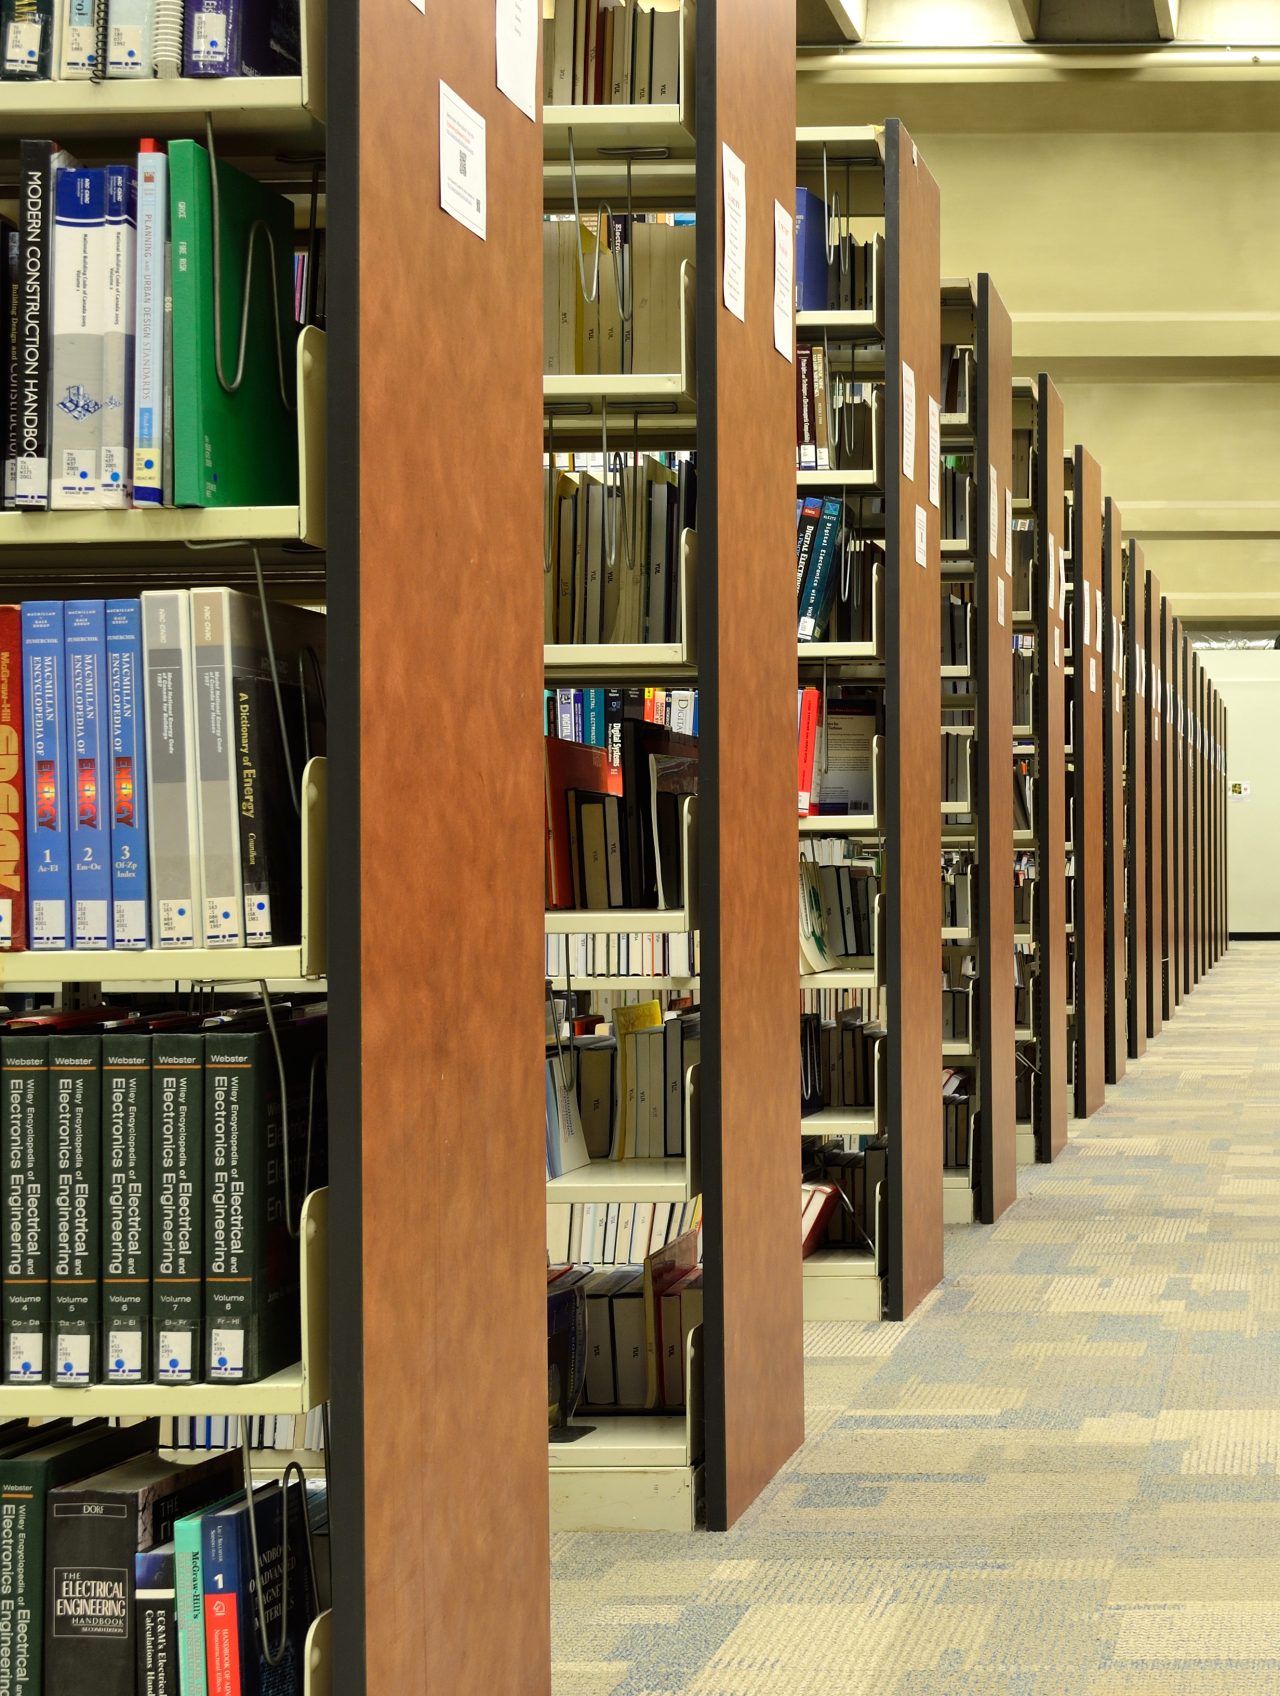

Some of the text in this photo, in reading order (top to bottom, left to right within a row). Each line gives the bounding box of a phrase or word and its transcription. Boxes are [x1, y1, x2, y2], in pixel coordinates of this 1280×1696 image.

[144, 214, 152, 258] PLANNING
[178, 241, 188, 272] FIRE RISK
[143, 274, 152, 304] URBAN
[22, 171, 42, 458] MODERN CONSTRUCTION HANDBO
[143, 307, 152, 339] DESIGN
[142, 342, 152, 400] STANDARDS
[822, 522, 832, 546] Digital
[813, 549, 826, 587] Electronics
[44, 656, 54, 721] MACMILLAN
[34, 656, 57, 831] ENCYCLOPEDIA OF ENERGY
[239, 692, 256, 819] A Dictionary of Energy
[612, 722, 622, 767] Digital Systems
[44, 849, 52, 863] 1
[108, 1056, 146, 1065] Webster
[210, 1055, 249, 1063] Webster
[108, 1077, 126, 1275] Electronics Engineering
[127, 1077, 142, 1275] Wiley Encyclopedia of Electrical and
[211, 1076, 228, 1273] Electronics Engineering
[229, 1076, 245, 1274] Wiley Encyclopedia of Electrical and
[109, 1295, 142, 1303] Volume
[121, 1304, 128, 1312] 6
[213, 1294, 245, 1302] Volume
[225, 1303, 232, 1311] 8
[83, 1504, 104, 1515] DORF
[62, 1580, 126, 1599] ELECTRICAL
[63, 1572, 82, 1580] THE
[192, 1551, 202, 1620] McGraw-Hill's
[213, 1573, 224, 1589] 1
[56, 1598, 126, 1617] ENGINEERING
[72, 1616, 124, 1626] HANDBOOK
[145, 1609, 155, 1669] Calculations
[156, 1610, 167, 1648] EC&M's
